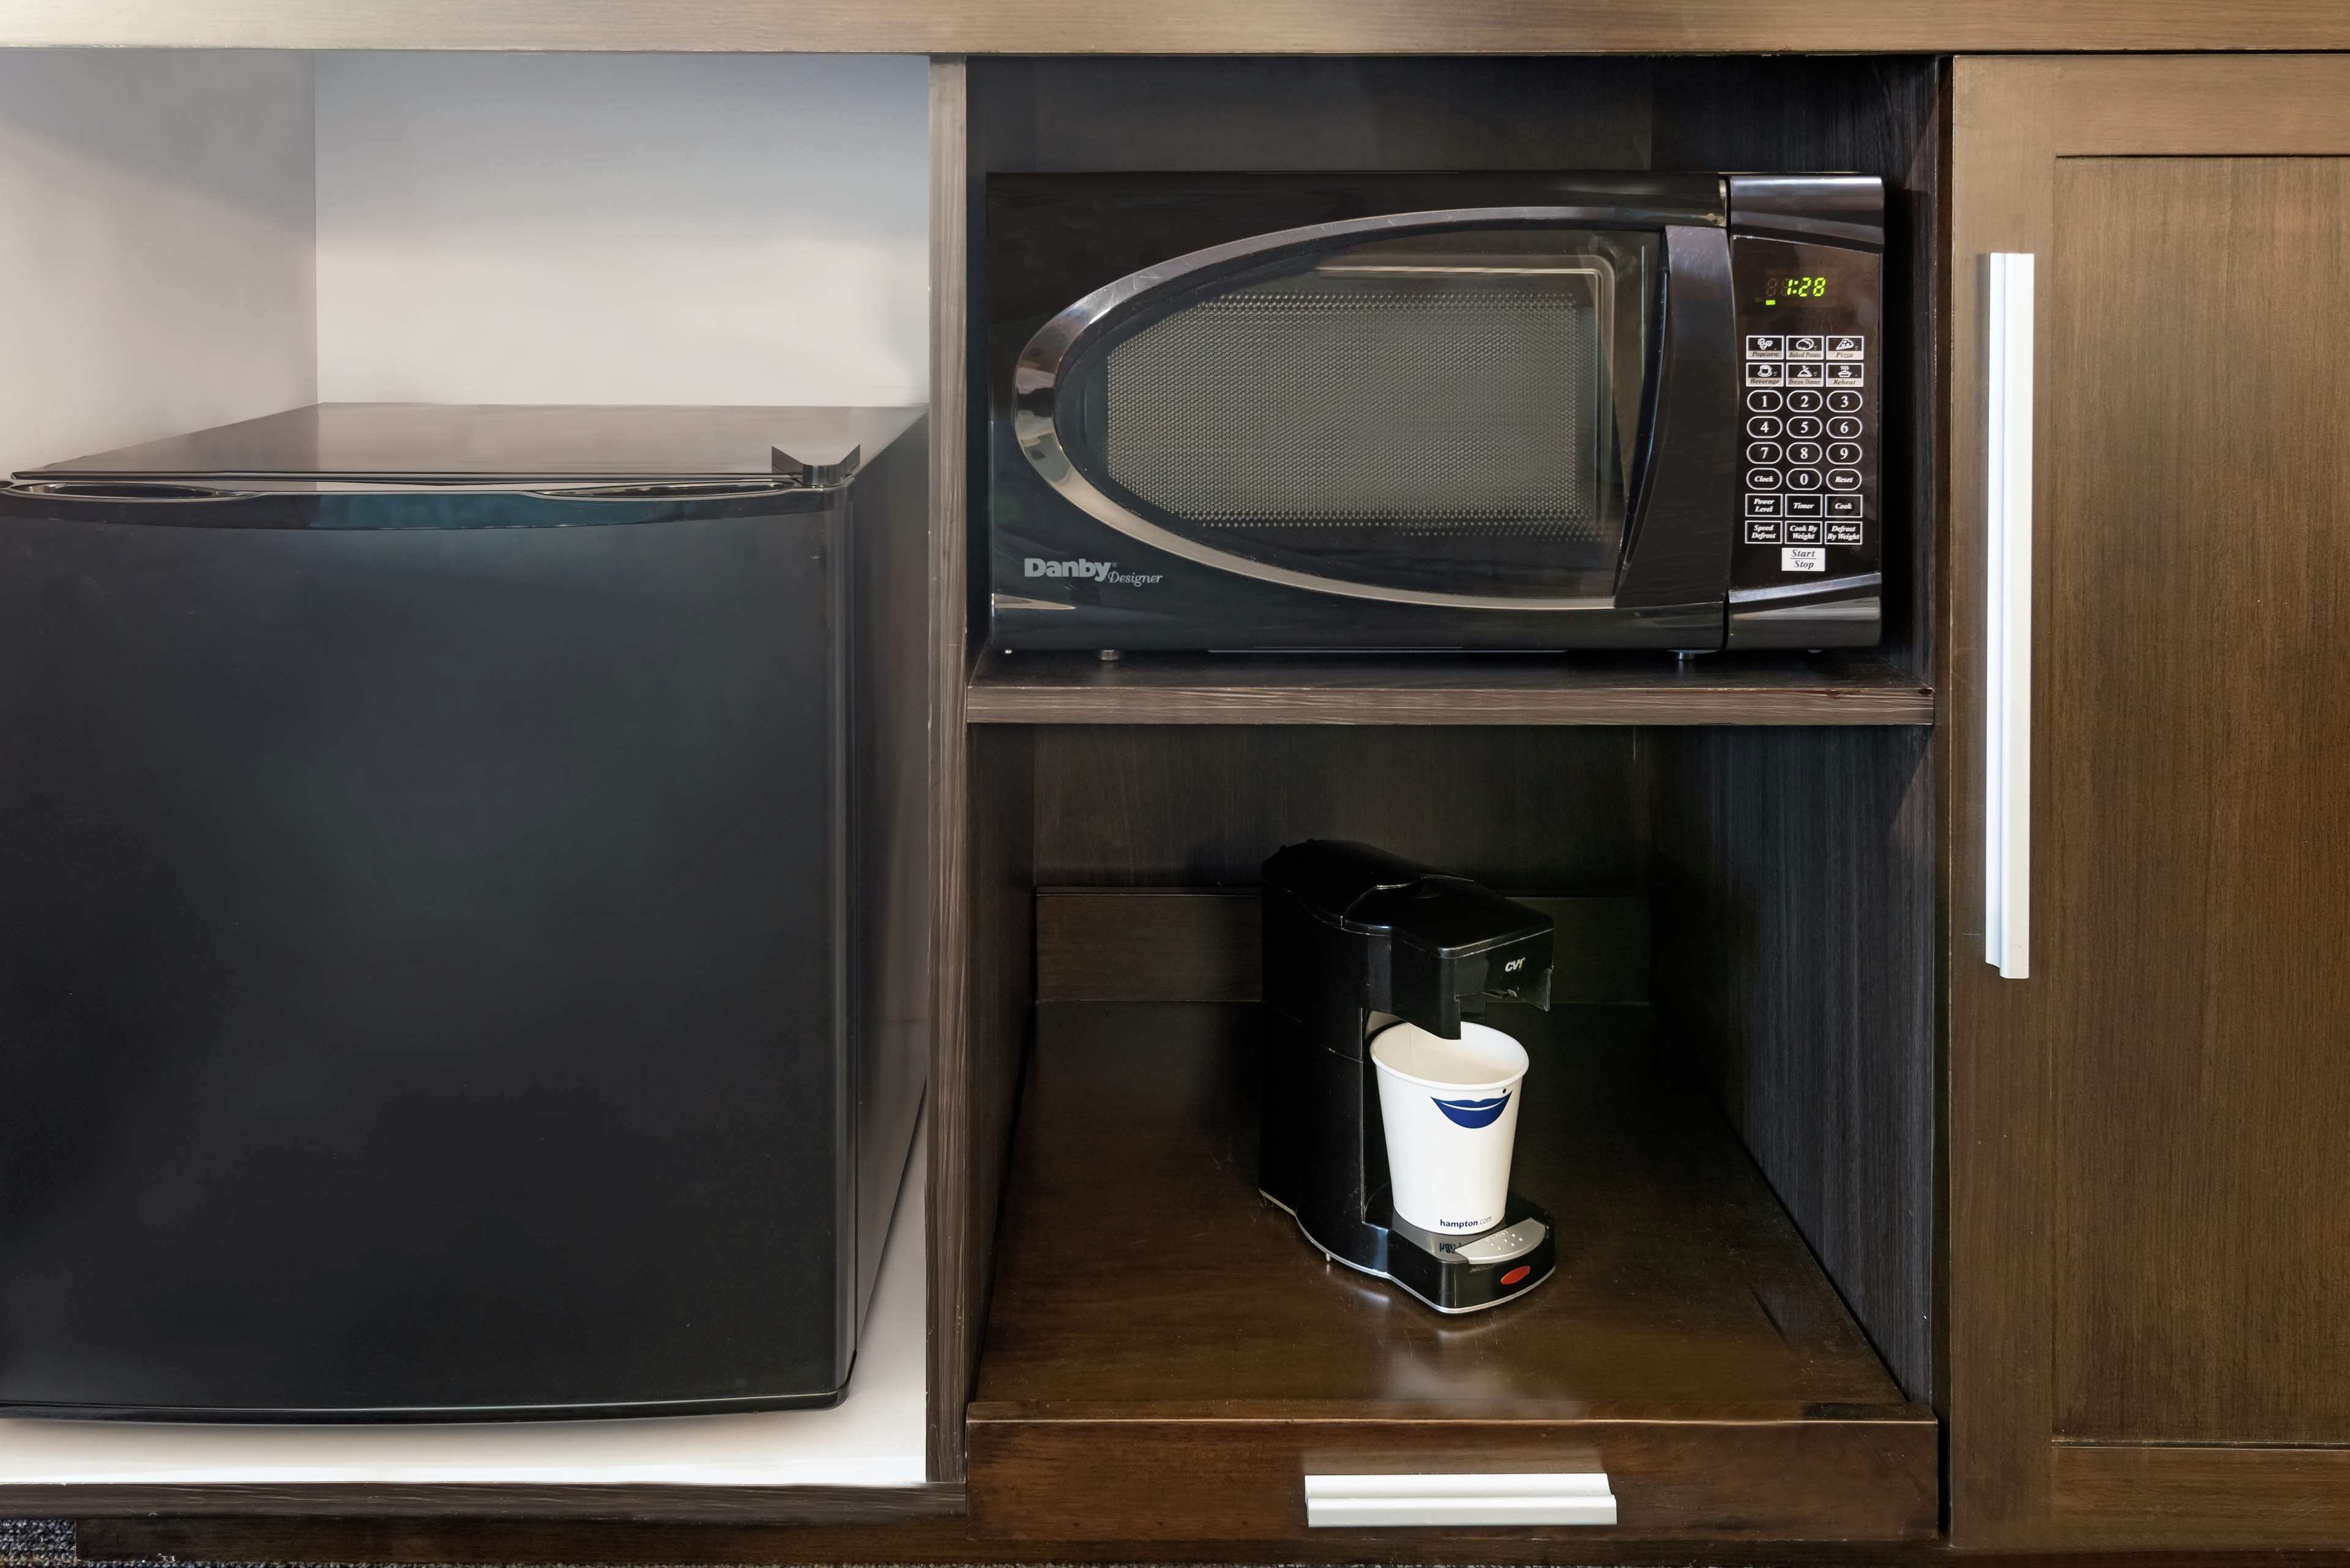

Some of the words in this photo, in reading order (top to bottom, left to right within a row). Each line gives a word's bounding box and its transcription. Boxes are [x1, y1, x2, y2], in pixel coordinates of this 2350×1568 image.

[1787, 277, 1826, 297] 1:28
[1762, 396, 1767, 407] 1
[1800, 396, 1809, 407] 2
[1841, 396, 1849, 407] 3
[1760, 422, 1769, 433] 4
[1800, 422, 1808, 433] 5
[1840, 422, 1849, 433] 6
[1760, 447, 1769, 458] 7
[1800, 447, 1808, 459] 8
[1839, 448, 1849, 459] 9
[1800, 474, 1809, 485] 0
[1791, 549, 1816, 558] Start
[1794, 559, 1814, 569] Stop
[1024, 558, 1112, 582] Danby
[1107, 572, 1163, 587] Designer
